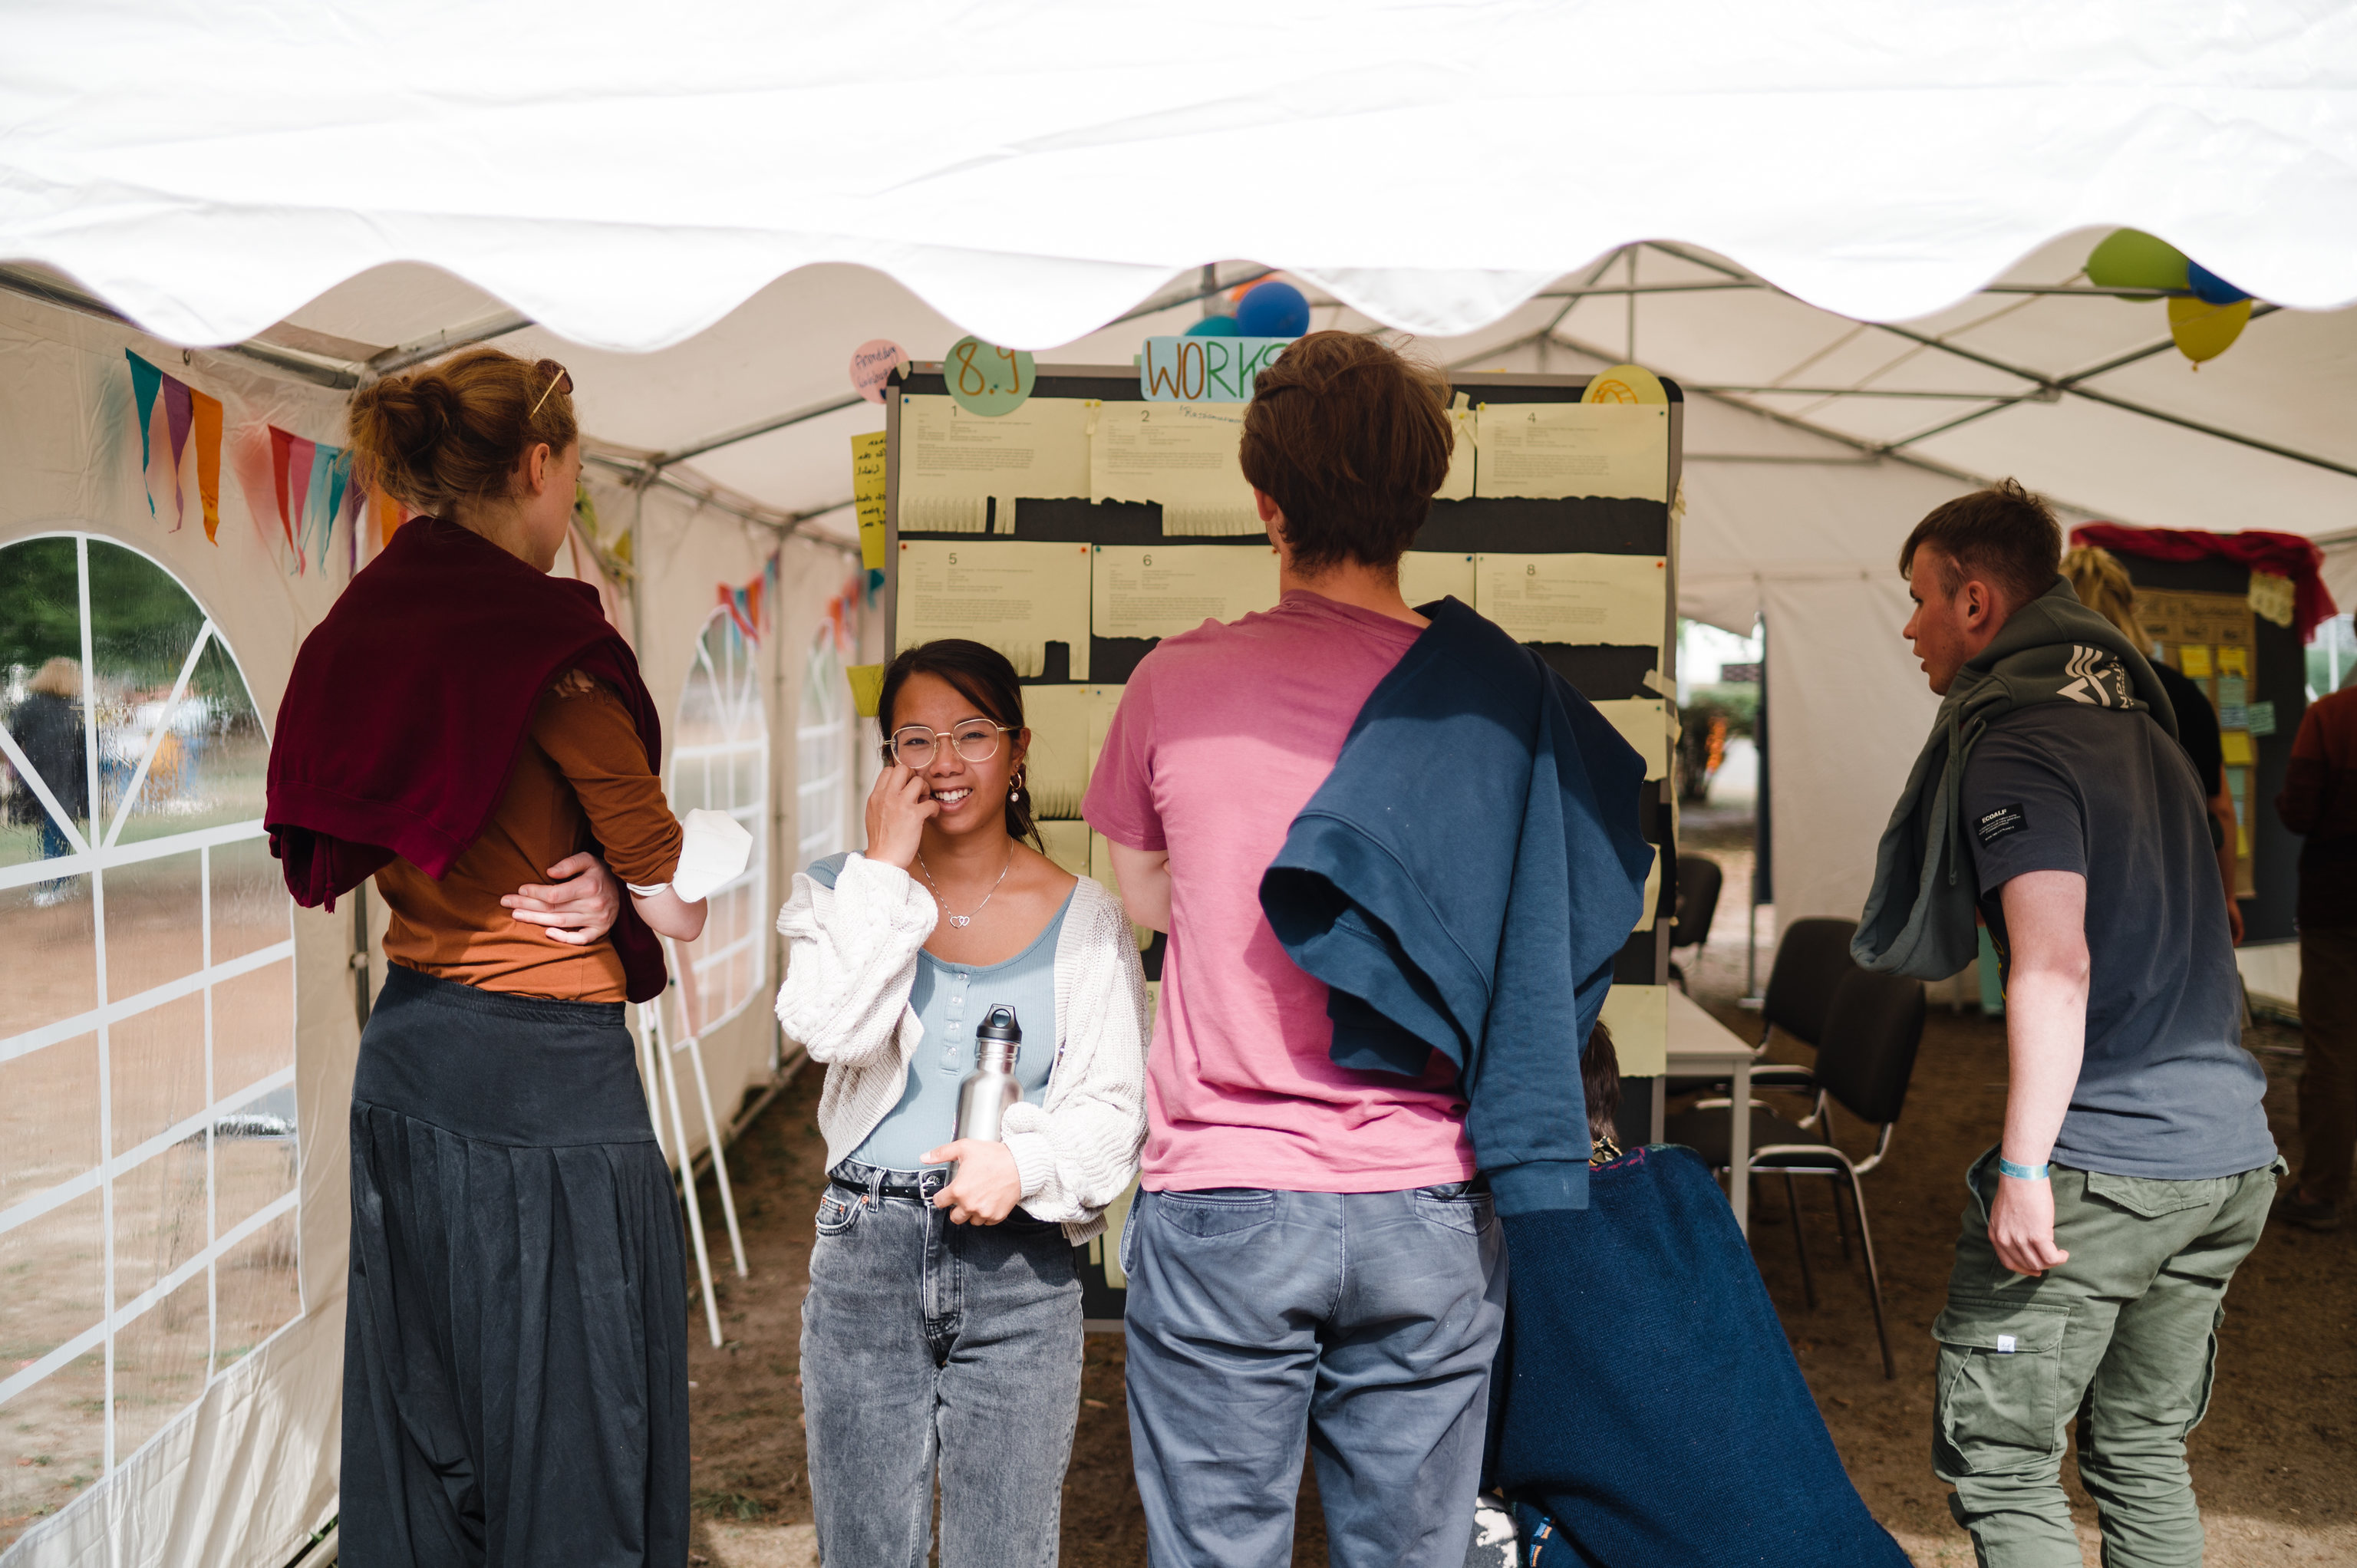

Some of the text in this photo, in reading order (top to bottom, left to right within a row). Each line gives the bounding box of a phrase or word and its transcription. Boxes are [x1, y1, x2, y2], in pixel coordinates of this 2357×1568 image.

[951, 404, 958, 417] 1
[1141, 410, 1150, 423] 2
[1527, 411, 1536, 424] 4
[948, 552, 958, 565] 5
[1142, 554, 1152, 566] 6
[1526, 564, 1536, 576] 8
